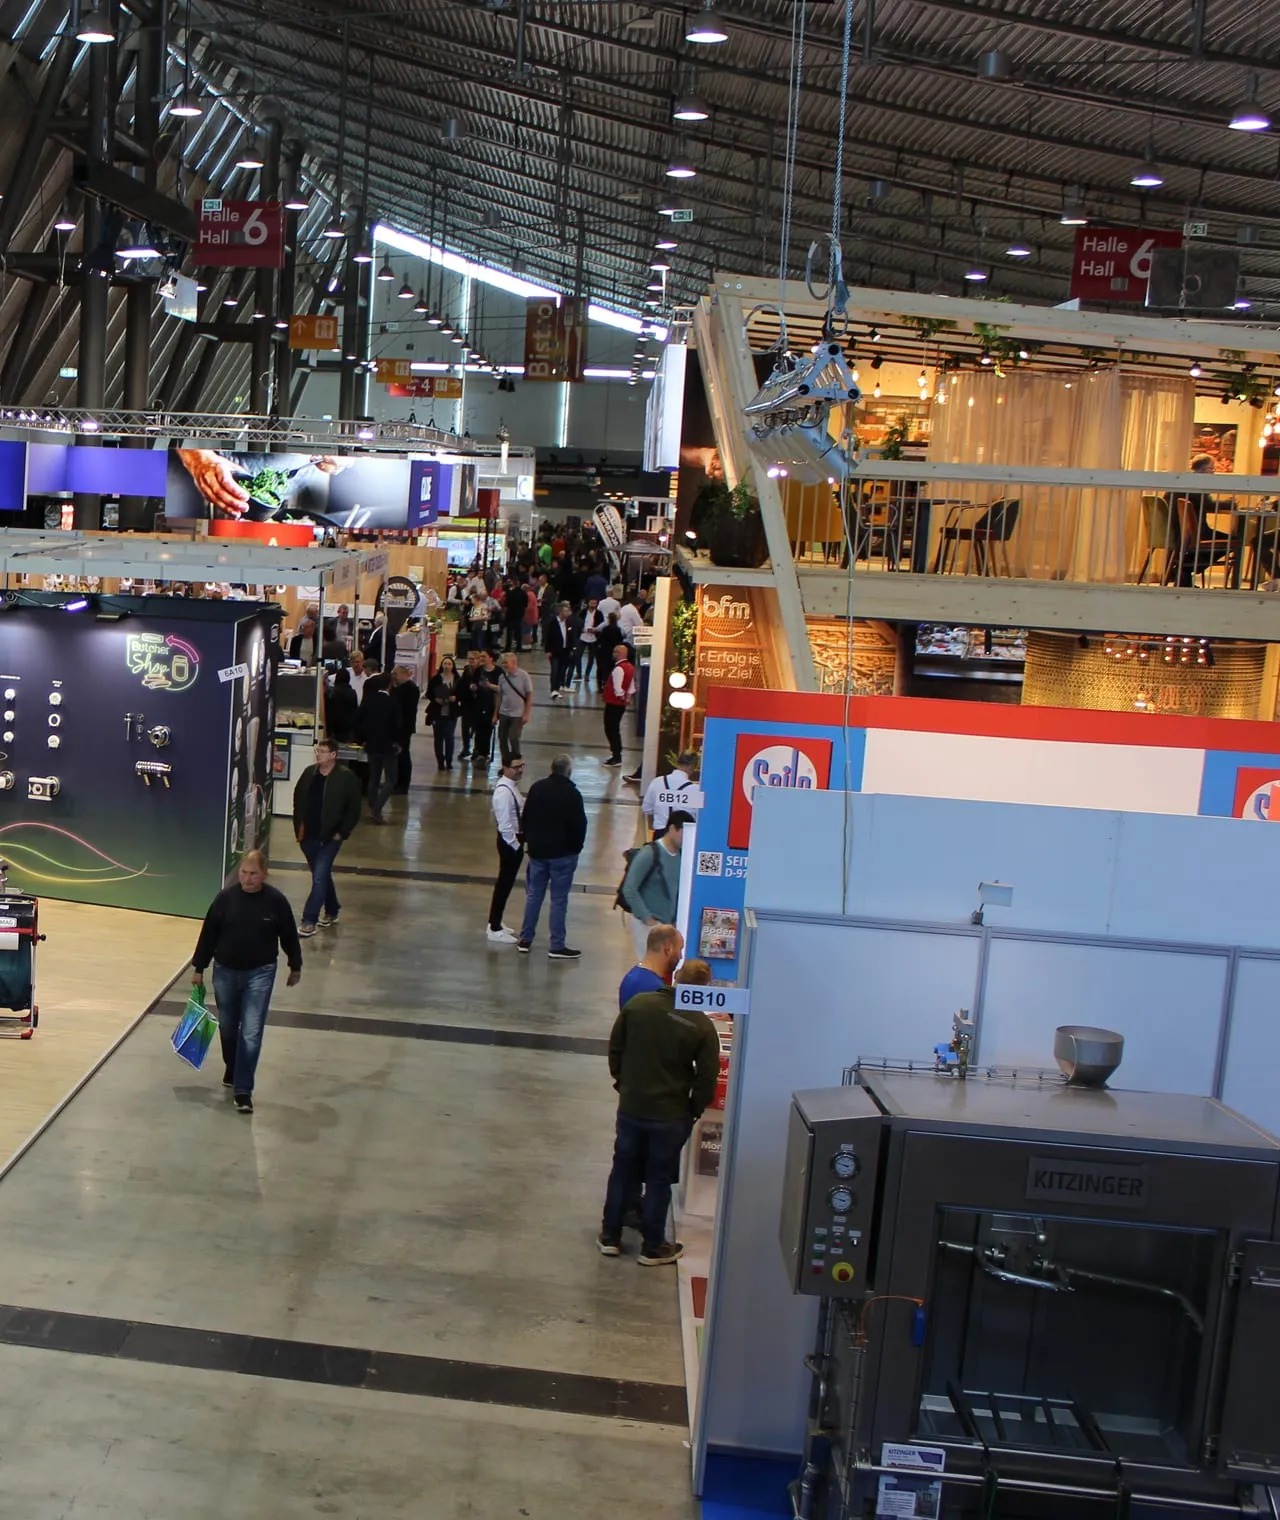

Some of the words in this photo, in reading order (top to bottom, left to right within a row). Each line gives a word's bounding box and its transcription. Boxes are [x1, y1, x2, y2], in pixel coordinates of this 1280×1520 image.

[243, 208, 268, 245] 6
[200, 229, 229, 244] Hall
[1083, 236, 1128, 253] Halle
[1130, 238, 1156, 279] 6
[1080, 260, 1115, 277] Hall
[703, 594, 750, 619] bfm
[131, 641, 170, 655] Butcher
[130, 653, 170, 674] Shop
[707, 650, 746, 667] Erfolg
[224, 666, 244, 677] 6A10
[728, 667, 752, 679] Ziel
[659, 793, 689, 804] 6B12
[703, 926, 736, 937] Boden
[680, 989, 726, 1007] 6B10
[1033, 1169, 1144, 1197] KITZINGER
